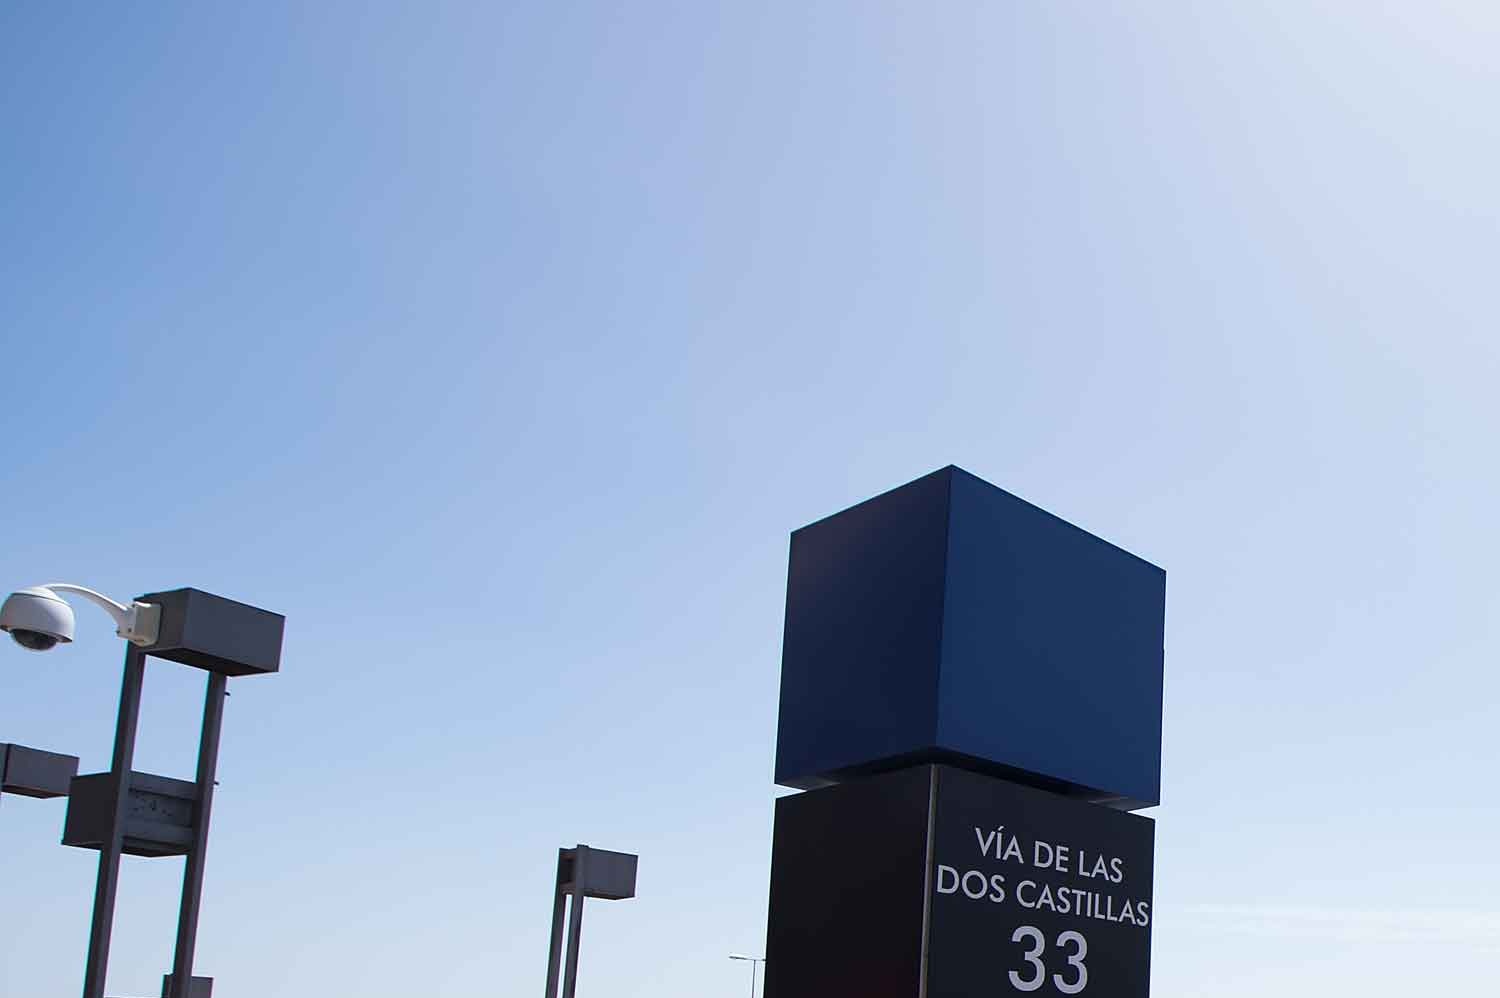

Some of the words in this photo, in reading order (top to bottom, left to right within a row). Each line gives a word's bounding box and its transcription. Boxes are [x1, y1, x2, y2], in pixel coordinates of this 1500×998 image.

[975, 825, 1024, 864] VÍA
[1034, 840, 1069, 872] DE
[1079, 850, 1123, 883] LAS
[936, 864, 1005, 903] DOS
[1016, 880, 1149, 927] CASTILLAS
[1008, 925, 1088, 995] 33
